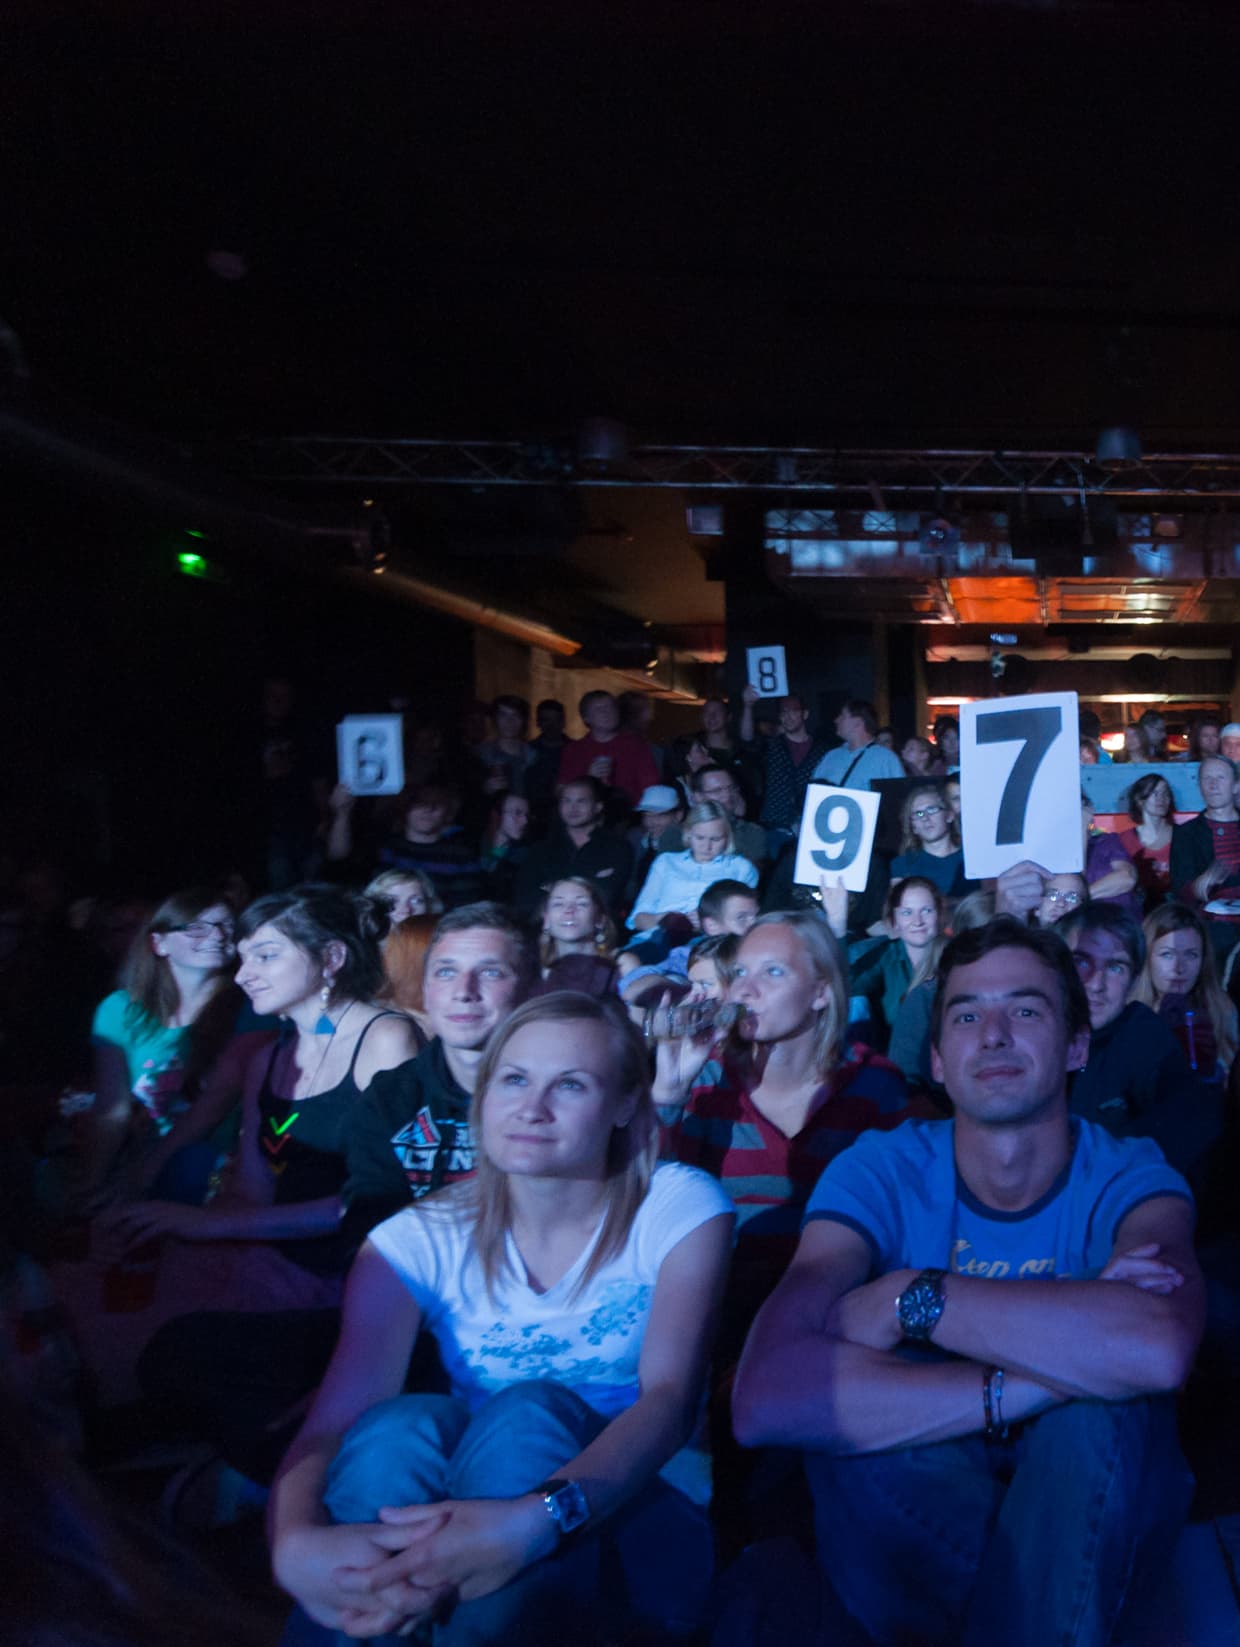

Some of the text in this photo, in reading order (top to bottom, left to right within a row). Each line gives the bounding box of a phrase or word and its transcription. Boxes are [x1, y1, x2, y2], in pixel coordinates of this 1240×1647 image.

[759, 656, 777, 693] 8
[976, 706, 1062, 846] 7
[810, 794, 863, 871] 9
